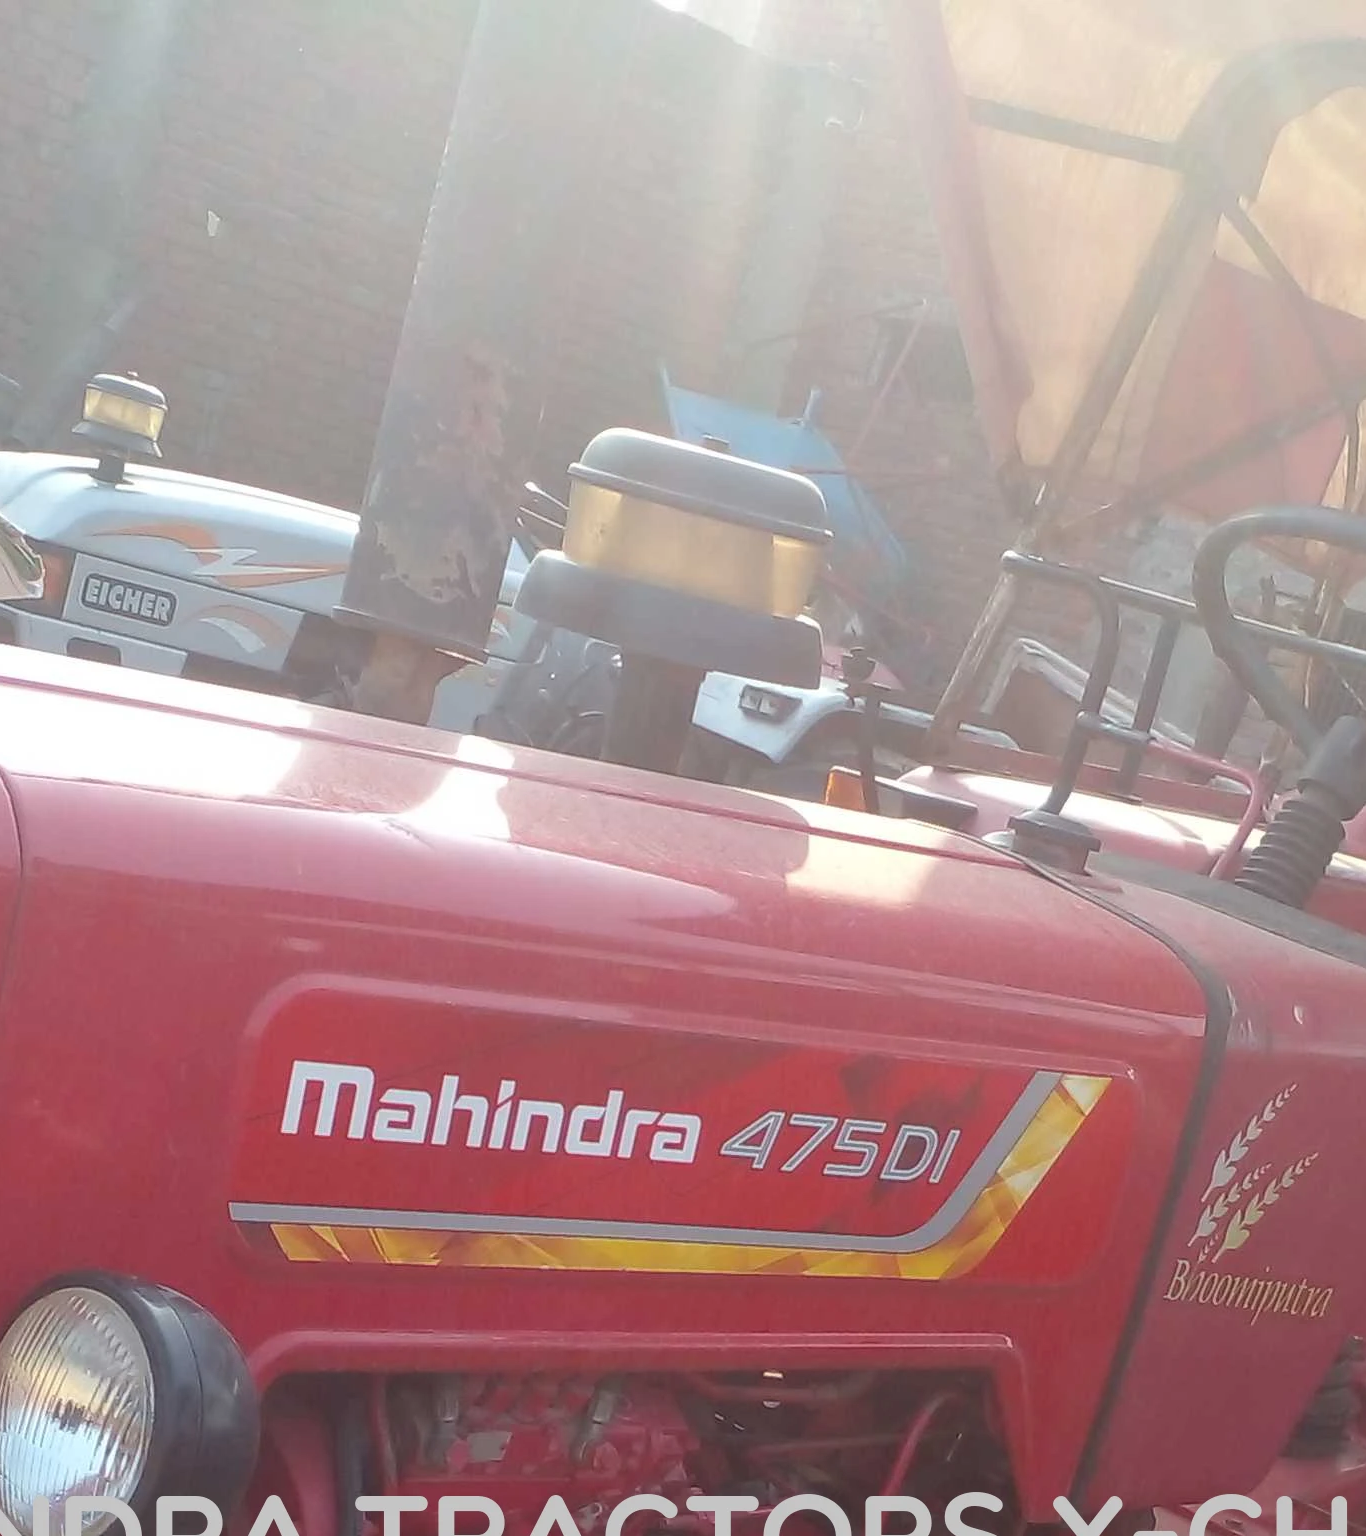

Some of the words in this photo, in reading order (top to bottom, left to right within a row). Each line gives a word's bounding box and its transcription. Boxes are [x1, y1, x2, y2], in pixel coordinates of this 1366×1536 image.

[85, 577, 173, 622] EICHER
[280, 1060, 702, 1164] Mahindra
[720, 1110, 961, 1184] 475DI
